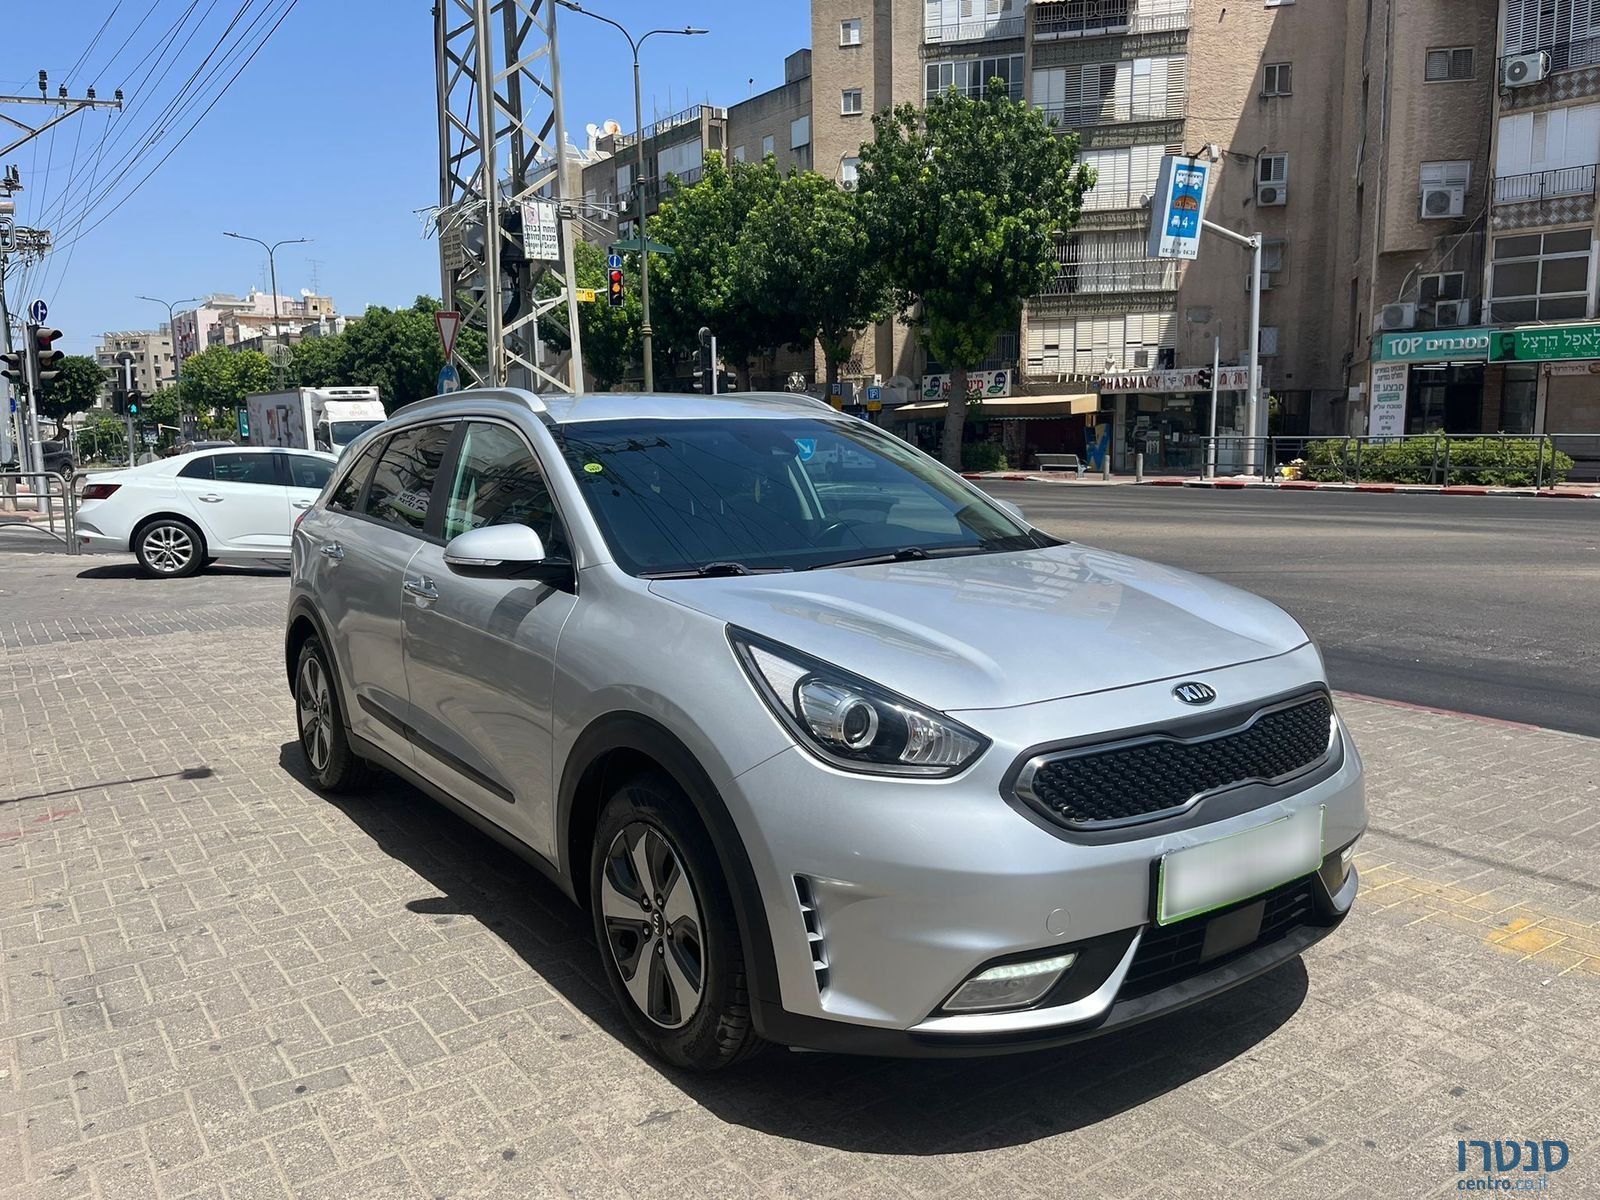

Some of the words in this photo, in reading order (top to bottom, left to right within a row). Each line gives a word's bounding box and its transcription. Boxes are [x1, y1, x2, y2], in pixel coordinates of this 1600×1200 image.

[1388, 337, 1423, 356] TOP
[1426, 336, 1489, 351] מטבחים
[1101, 375, 1160, 390] PHARMACY
[1177, 684, 1214, 702] KIA
